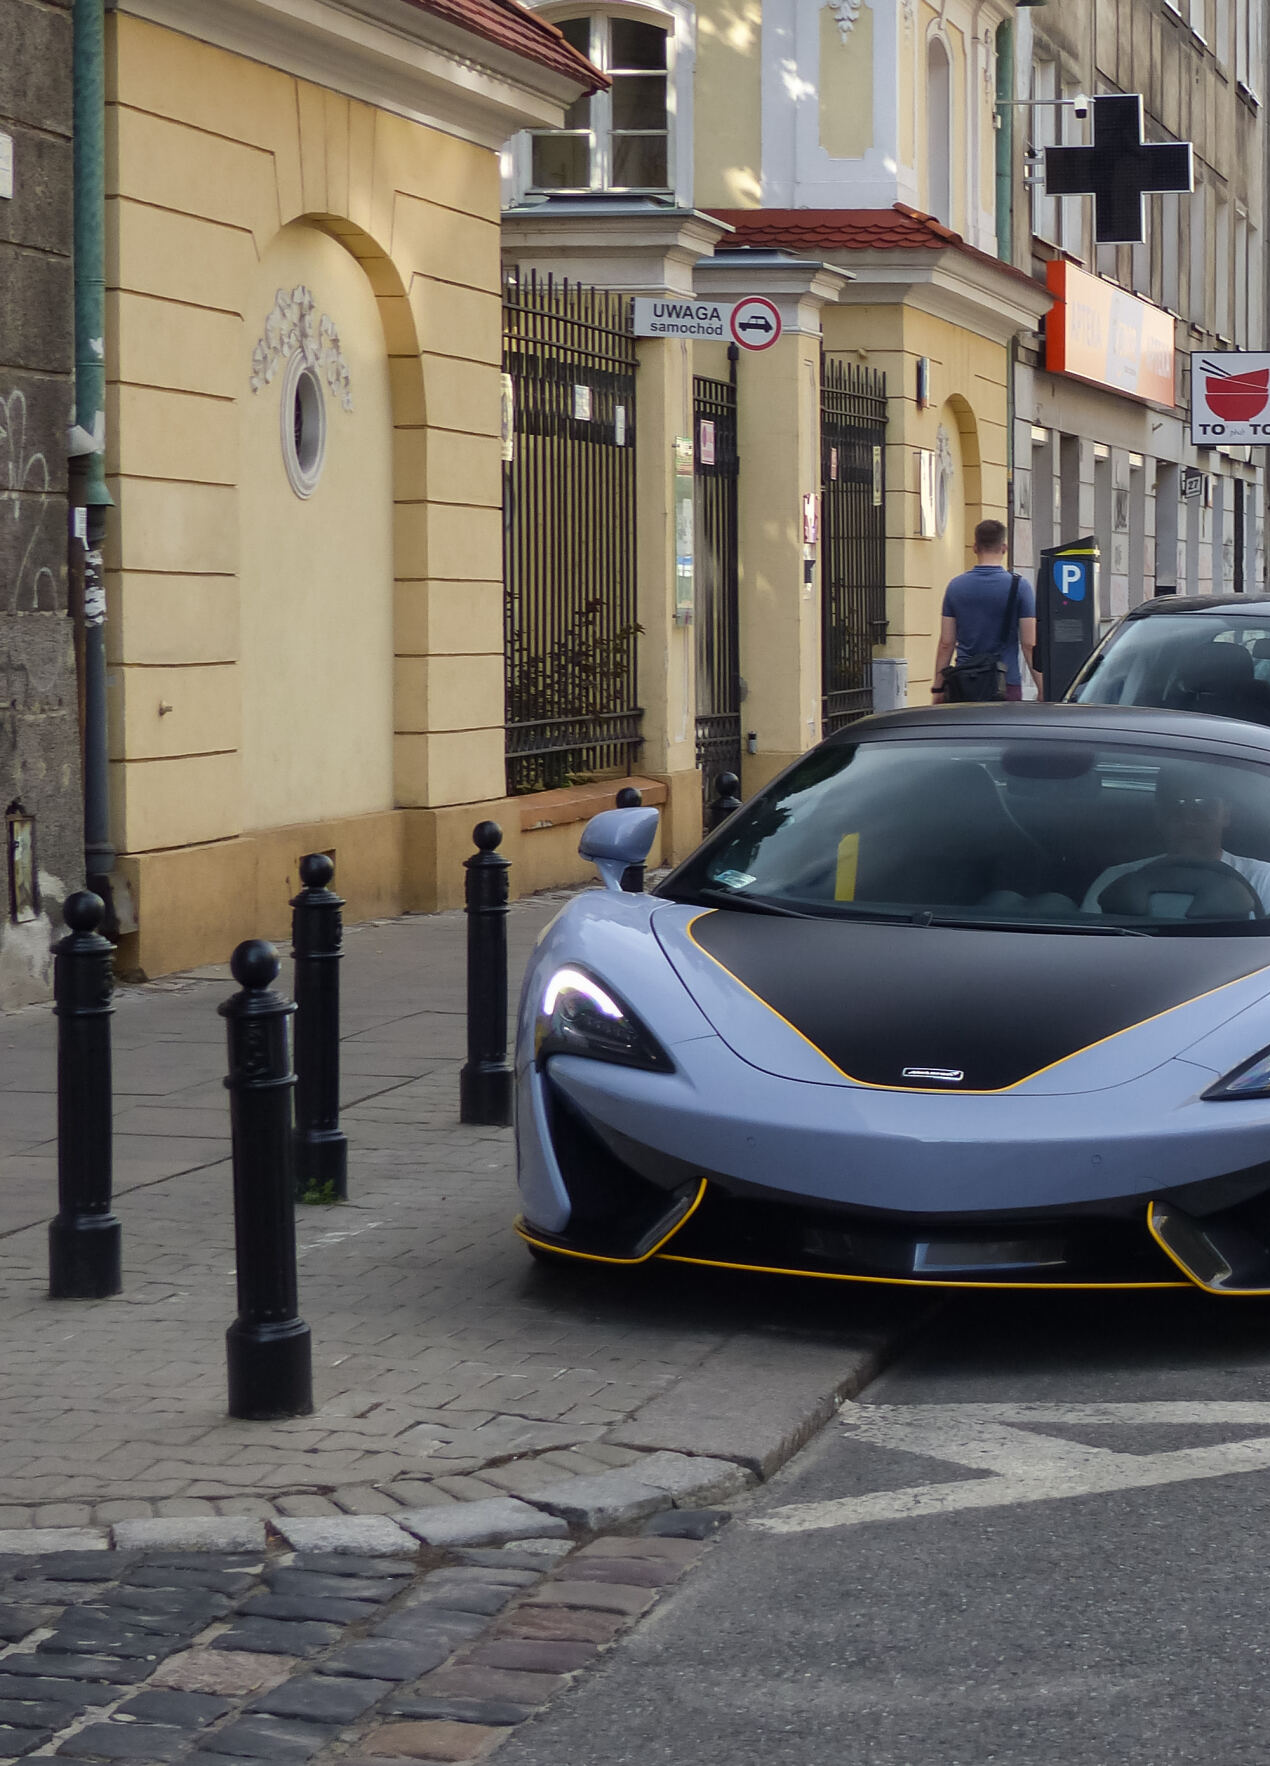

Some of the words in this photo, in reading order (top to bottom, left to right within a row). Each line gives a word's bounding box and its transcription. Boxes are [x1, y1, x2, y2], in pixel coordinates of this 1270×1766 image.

[653, 303, 722, 321] UWAGA
[650, 322, 723, 336] samochód
[1198, 423, 1226, 436] TO
[1187, 479, 1199, 490] 27
[1062, 564, 1081, 594] P
